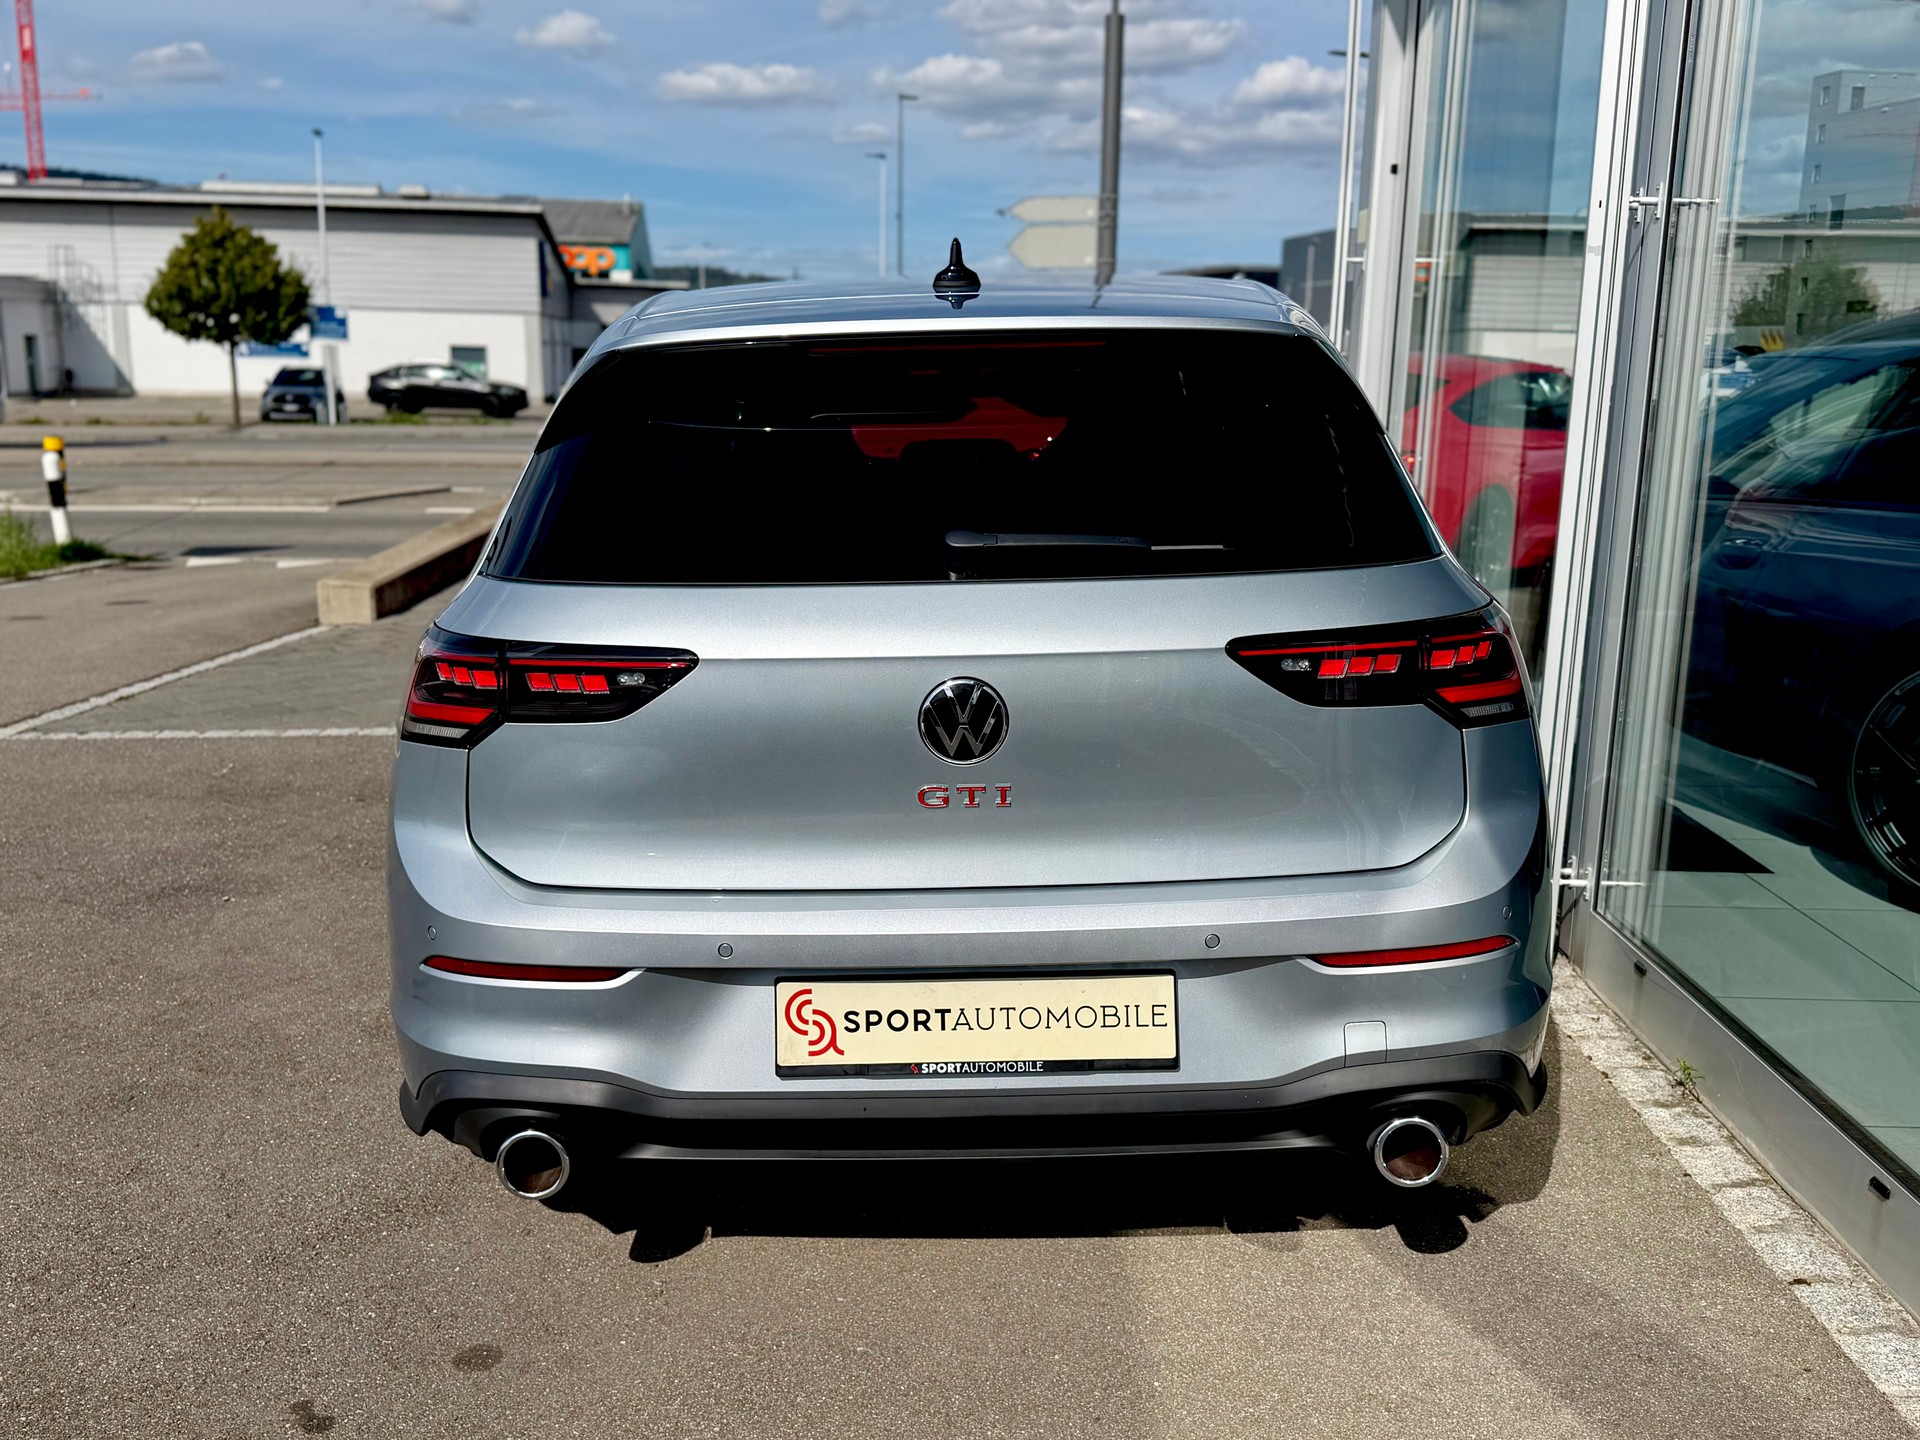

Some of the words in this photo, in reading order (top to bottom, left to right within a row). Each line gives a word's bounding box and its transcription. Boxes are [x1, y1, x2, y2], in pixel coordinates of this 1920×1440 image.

[557, 244, 616, 276] oop
[917, 783, 1012, 808] GTI
[843, 1003, 1169, 1033] SPORTAUTOMOBILE
[921, 1061, 1044, 1073] SPORTAUTOMOBILE
